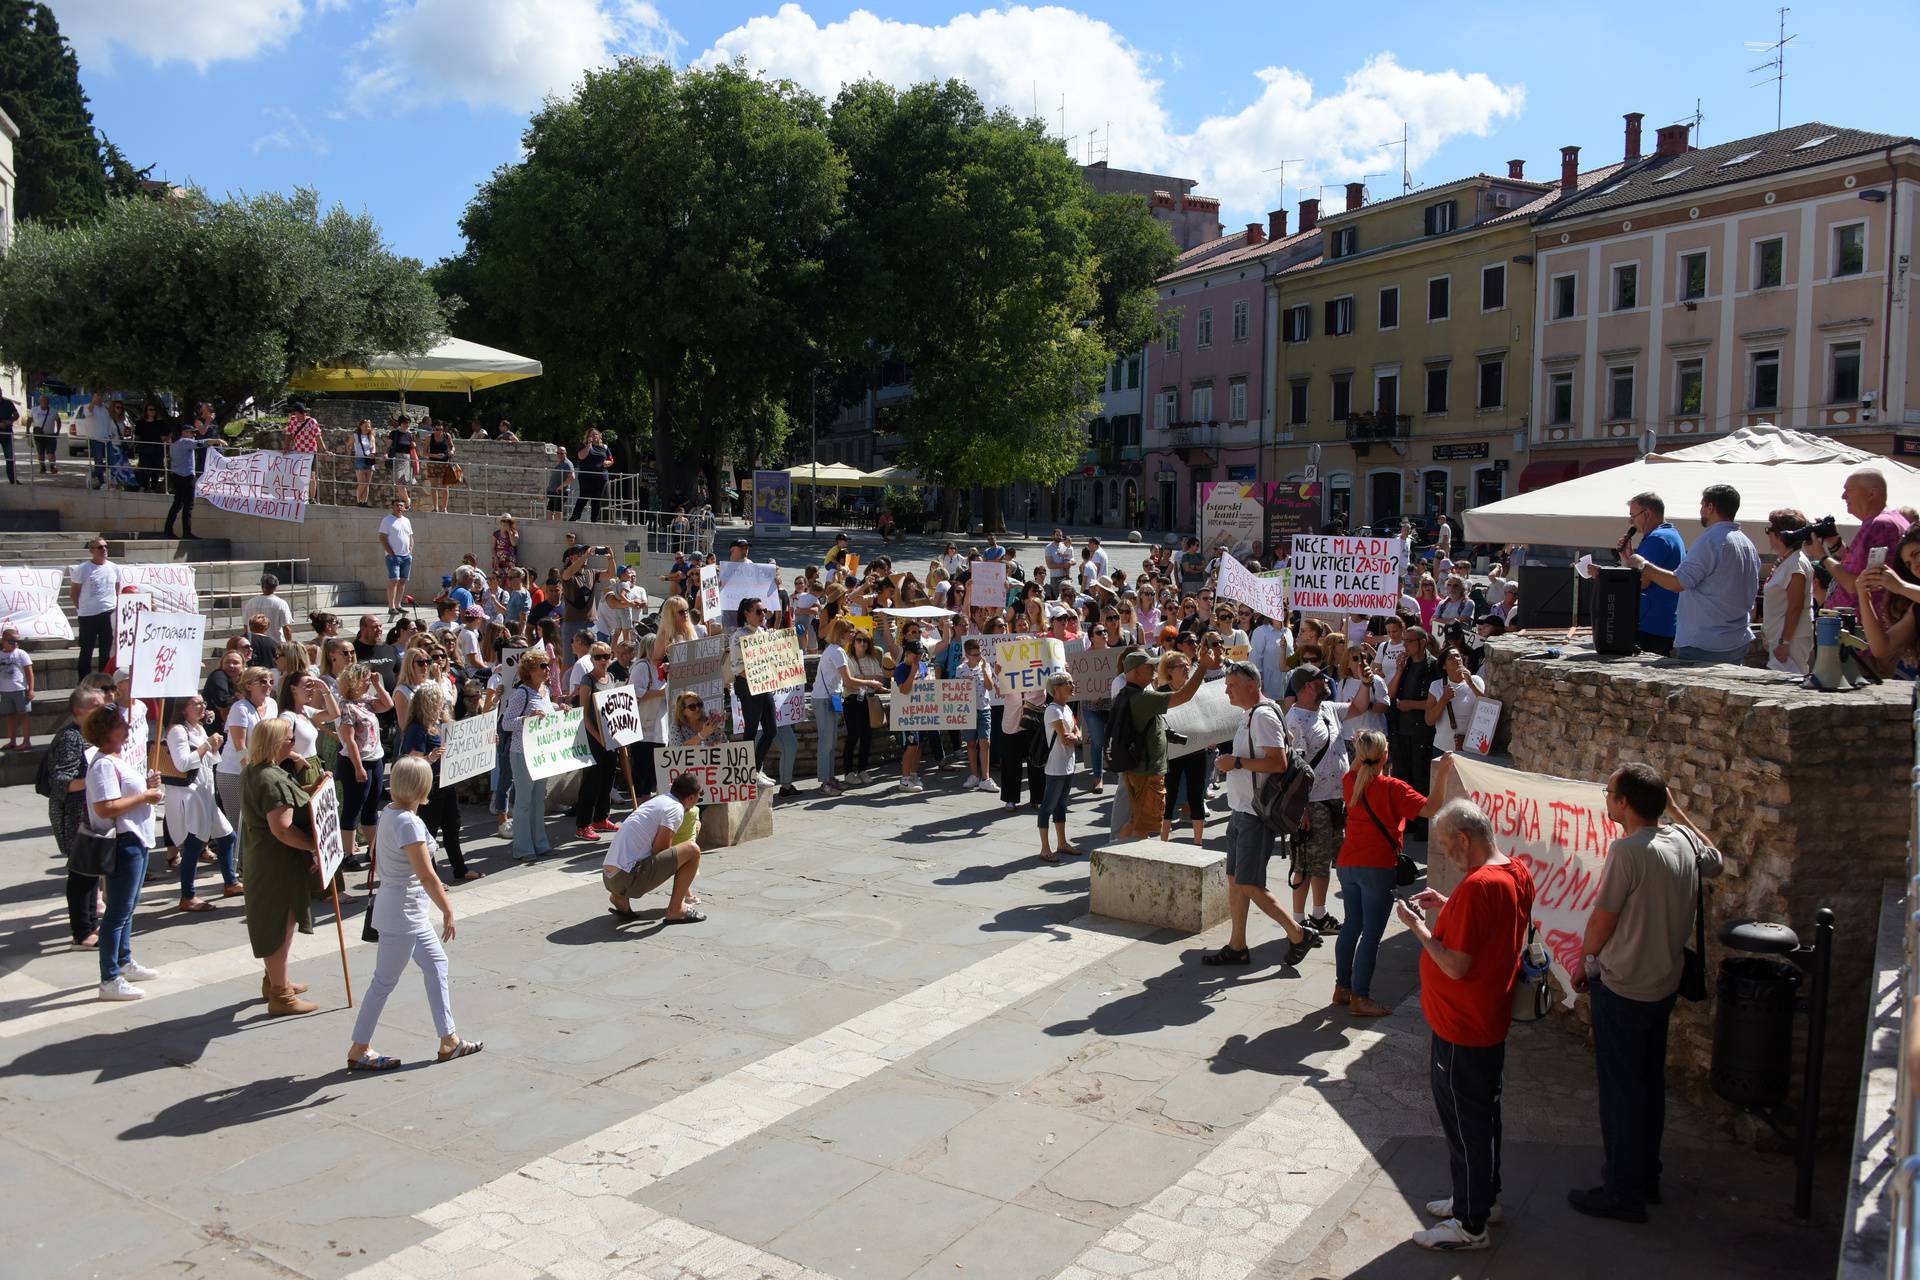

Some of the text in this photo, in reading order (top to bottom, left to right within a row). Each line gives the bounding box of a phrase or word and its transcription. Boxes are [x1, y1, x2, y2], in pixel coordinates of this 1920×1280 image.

[1295, 537, 1388, 556] NEĆE MLADI
[1295, 557, 1305, 570] U
[17, 568, 63, 591] BILO
[1294, 575, 1327, 589] MALE
[1293, 591, 1398, 609] VELIKA ODGOVORNOST
[142, 622, 197, 643] SOTTOPAGATE
[902, 703, 939, 716] NEMAM
[607, 713, 638, 737] ZAKON!
[898, 714, 940, 726] POŠTENE
[446, 734, 484, 759] ZAMJENA
[660, 746, 749, 769] SVE JE NA
[669, 766, 757, 786] RTE ZBOG
[1549, 801, 1628, 858] TETAM
